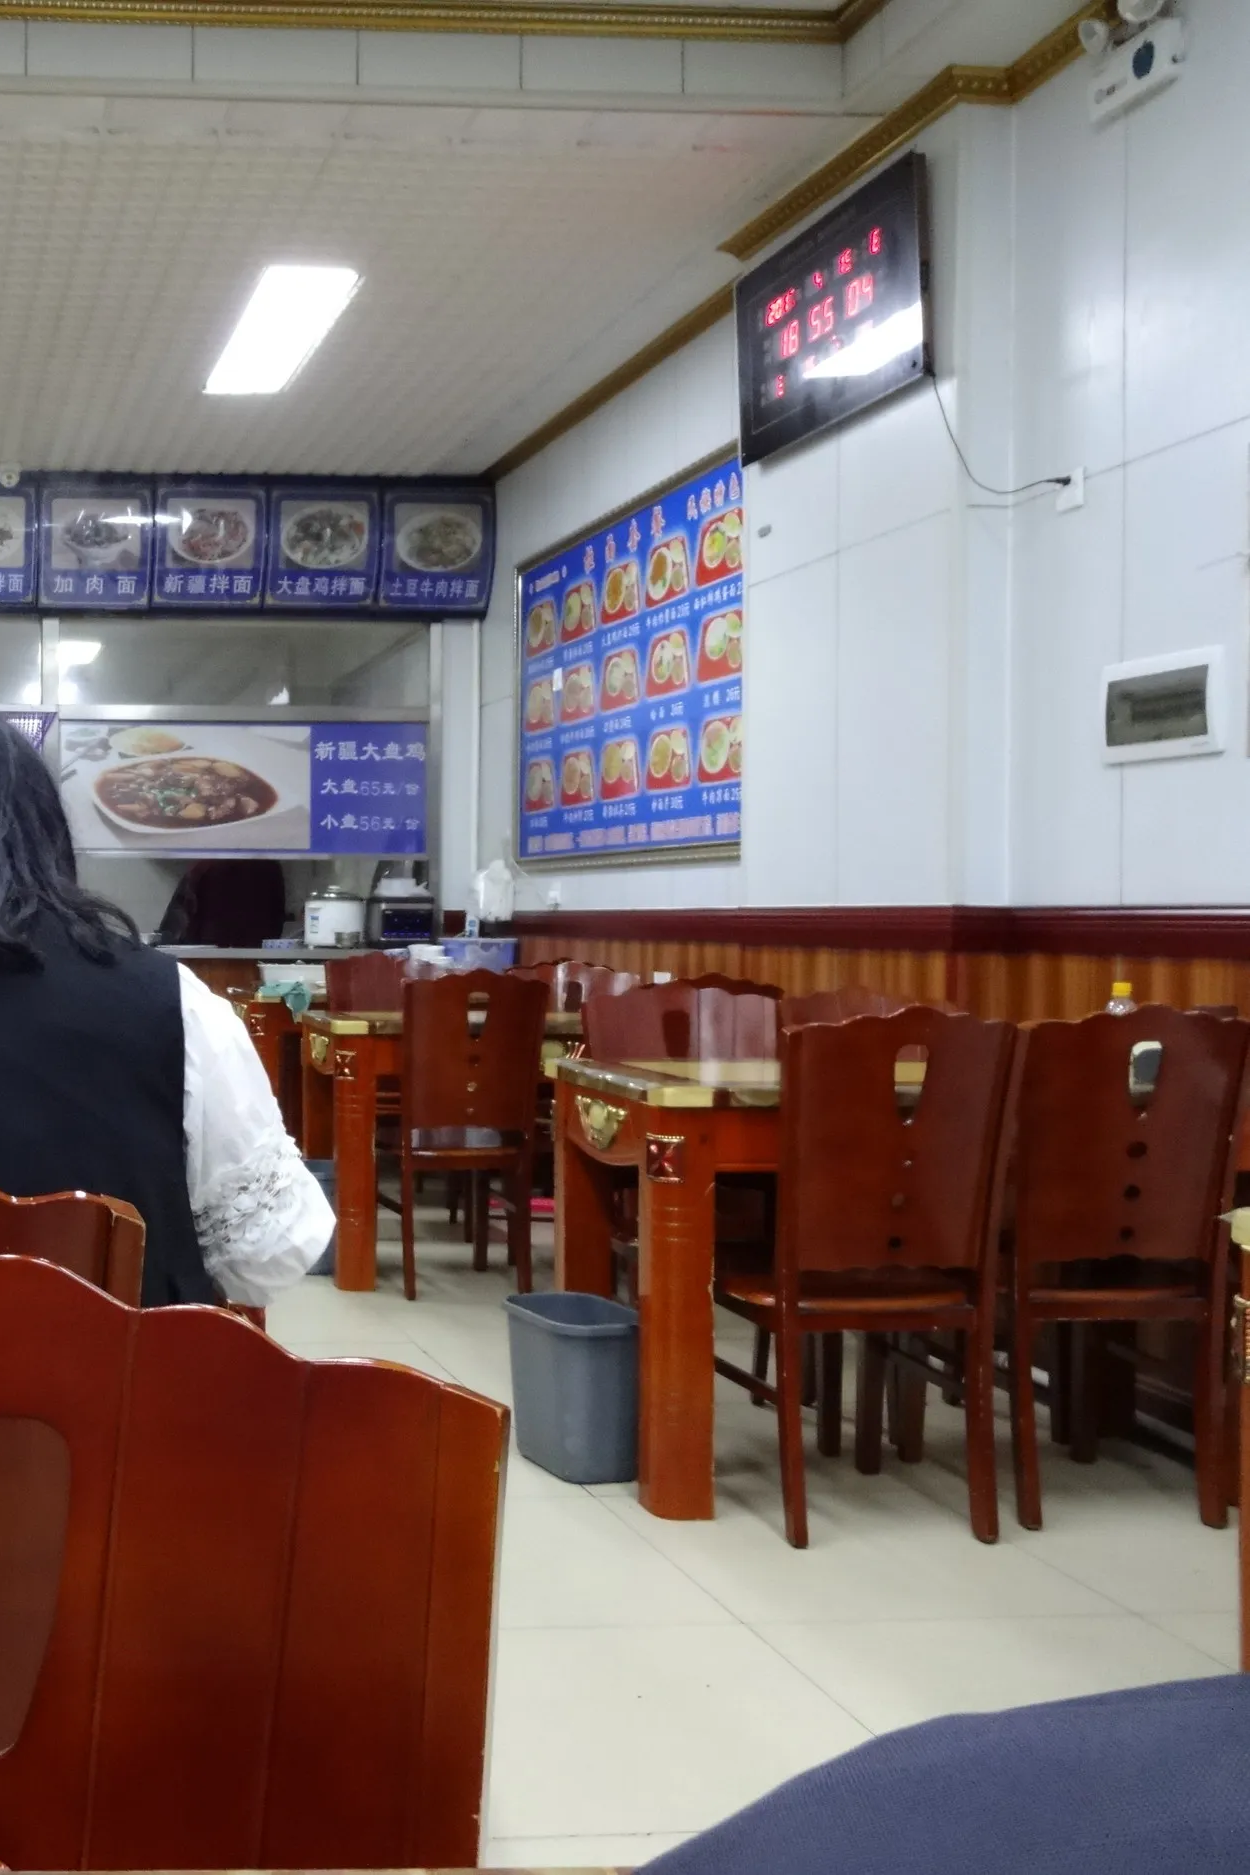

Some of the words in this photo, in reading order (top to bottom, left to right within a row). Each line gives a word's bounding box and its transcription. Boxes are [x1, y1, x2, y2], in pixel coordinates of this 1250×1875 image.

[780, 319, 800, 359] 18
[807, 295, 835, 344] 55
[844, 273, 874, 320] 04
[53, 574, 137, 596] 加肉面
[163, 573, 252, 596] 新疆拌面
[276, 577, 367, 597] 大盘鸡拌面
[389, 577, 481, 599] 土豆牛肉拌面
[314, 740, 427, 762] 新疆大盘鸡
[320, 778, 421, 797] 大盘65元/份
[320, 813, 421, 832] 小盘56元/份
